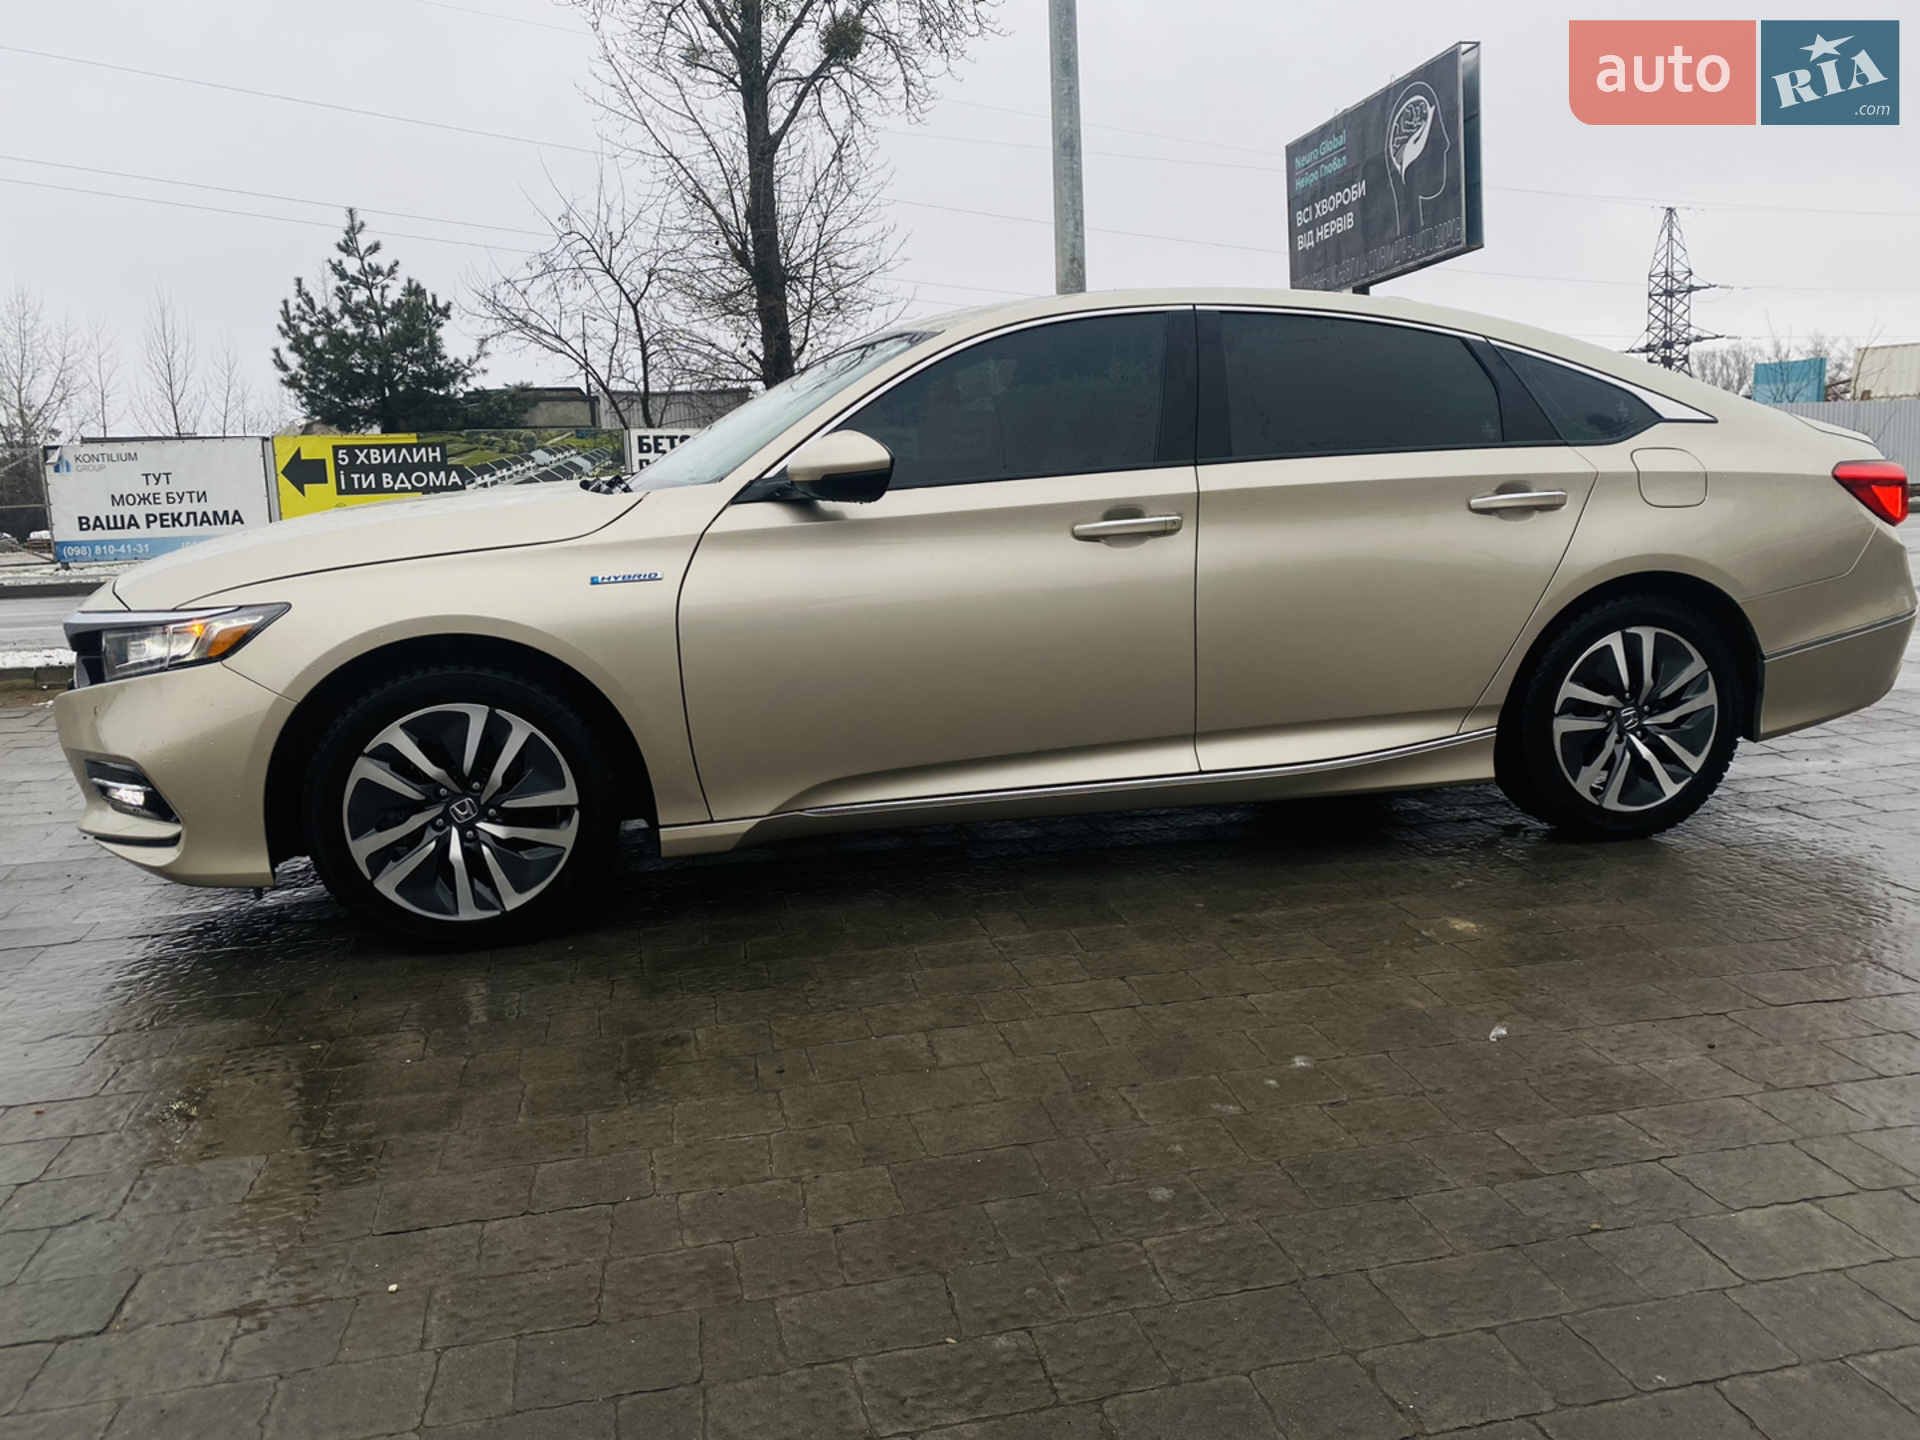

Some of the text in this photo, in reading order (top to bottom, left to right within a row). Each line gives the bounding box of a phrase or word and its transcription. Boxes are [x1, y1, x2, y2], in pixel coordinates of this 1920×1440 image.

[1295, 129, 1346, 170] Neuro Global
[1295, 155, 1347, 191] Нейро Глобал
[1296, 179, 1366, 227] ВСІ ХВОРОБИ
[1297, 211, 1354, 251] ВІД НЕРВІВ
[74, 452, 139, 464] KONTILIUM
[337, 446, 441, 465] 5 ХВИЛИН
[75, 463, 106, 473] GROUP
[141, 472, 172, 486] ТУТ
[350, 472, 376, 489] ТИ
[382, 470, 462, 490] ВДОМА
[110, 490, 208, 507] МОЖЕ БУТИ
[77, 509, 245, 532] ВАША РЕКЛАМА
[63, 543, 150, 558] (098) 810-41-31
[600, 572, 658, 582] HYBRID
